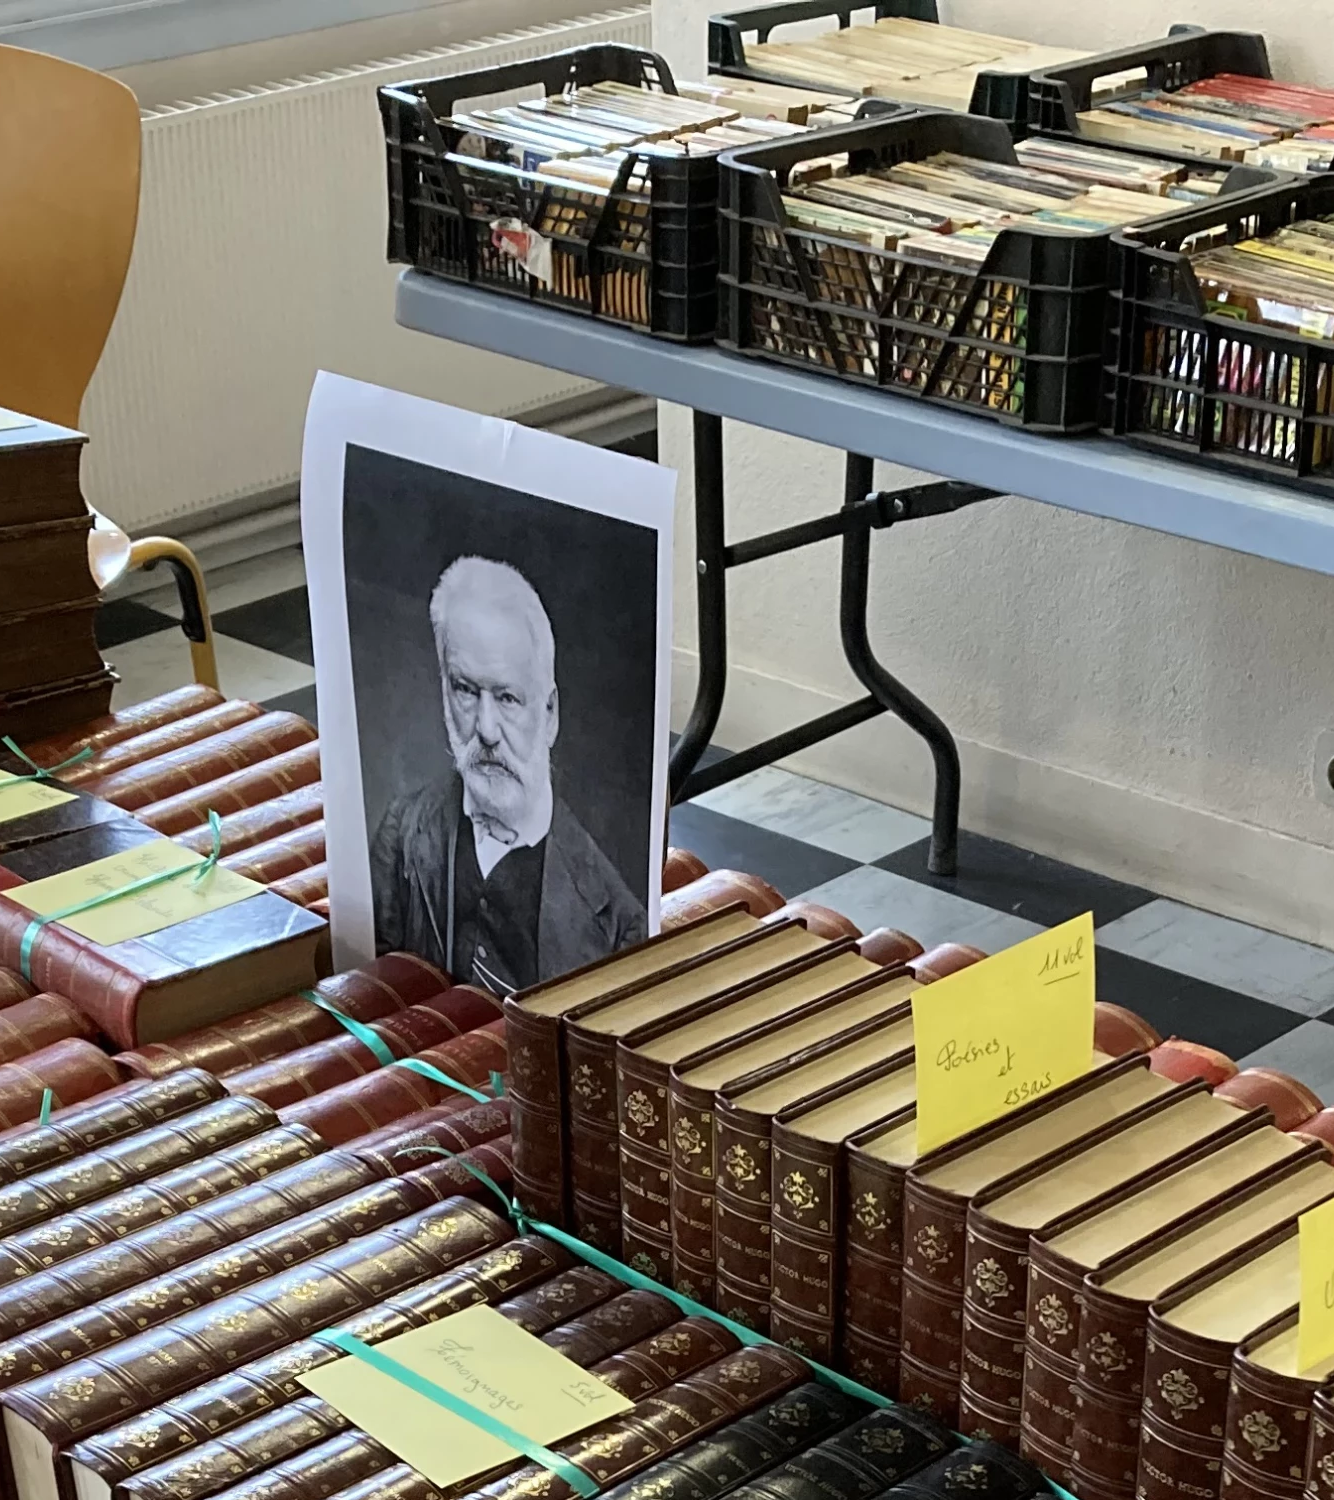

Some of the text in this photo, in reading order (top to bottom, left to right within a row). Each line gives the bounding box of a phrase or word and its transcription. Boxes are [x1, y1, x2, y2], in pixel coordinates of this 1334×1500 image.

[1062, 938, 1086, 967] vol
[935, 1033, 1002, 1073] Poésies
[996, 1044, 1017, 1081] et
[1002, 1070, 1054, 1108] essais
[802, 1275, 829, 1290] HUGO
[424, 1337, 525, 1413] Témoignages
[991, 1364, 1022, 1380] HUGO
[1141, 1457, 1215, 1500] VICTOR HUGO
